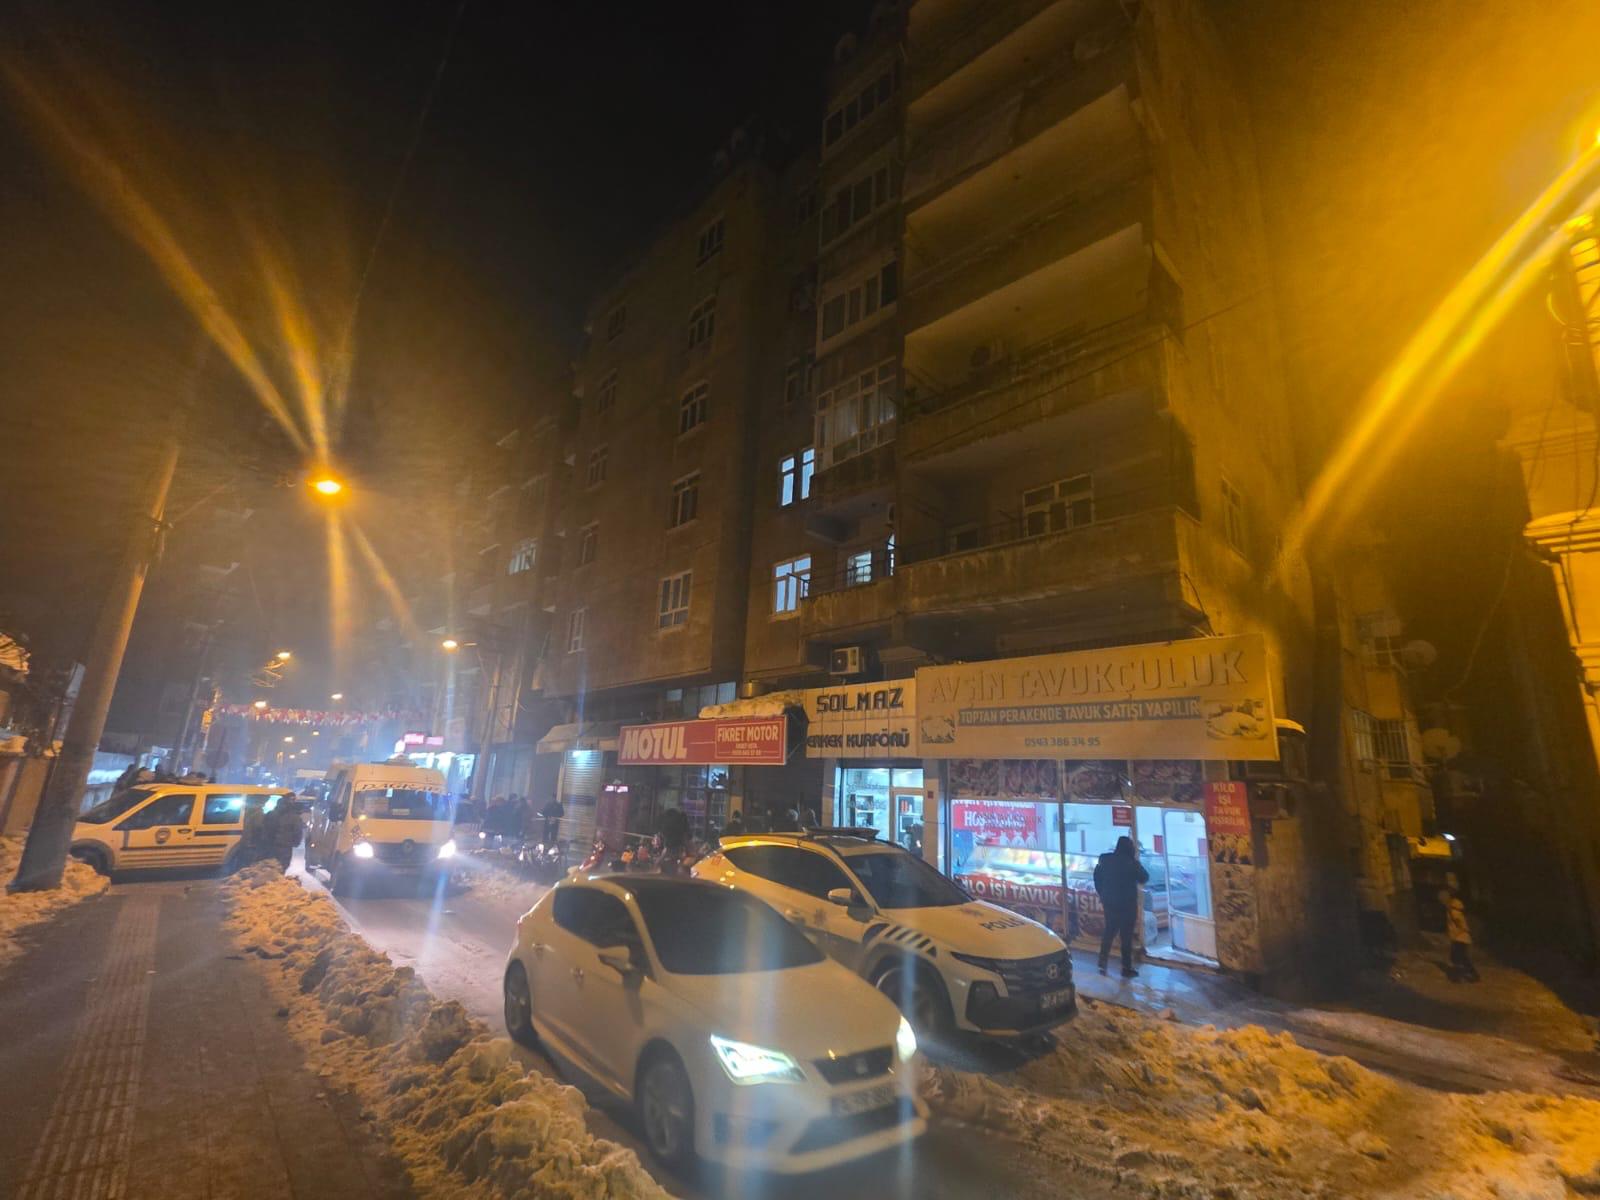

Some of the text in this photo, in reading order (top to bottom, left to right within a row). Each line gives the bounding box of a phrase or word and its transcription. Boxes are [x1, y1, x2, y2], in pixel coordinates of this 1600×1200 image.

[1012, 650, 1248, 699] TAVUKÇULUK
[816, 687, 904, 713] SOLMAZ
[960, 710, 998, 725] TOPTAN
[1000, 706, 1062, 723] PERAKENDE
[1065, 705, 1101, 721] TAVUK
[620, 726, 688, 760] MOTUL
[746, 724, 779, 741] MOTOR
[1010, 884, 1060, 905] TAVUK
